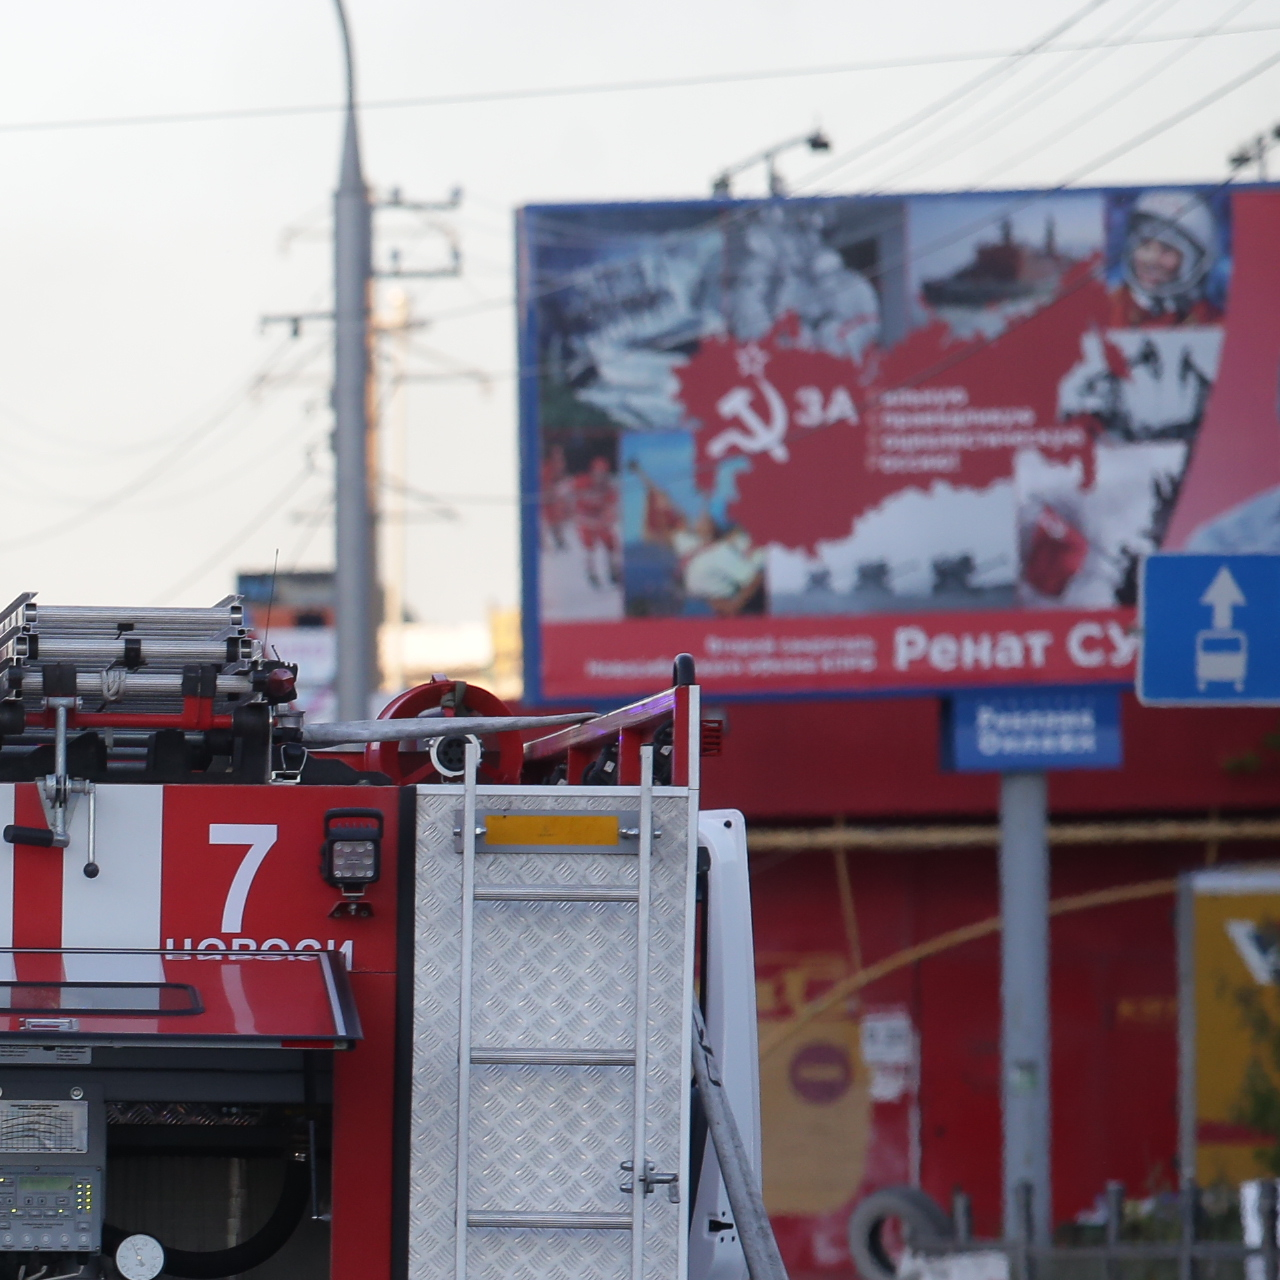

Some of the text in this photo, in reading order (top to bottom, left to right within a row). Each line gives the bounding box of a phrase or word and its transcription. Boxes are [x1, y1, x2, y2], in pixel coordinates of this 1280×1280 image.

[793, 385, 859, 428] ЗА
[894, 626, 1052, 671] Ренат
[209, 824, 278, 933] 7
